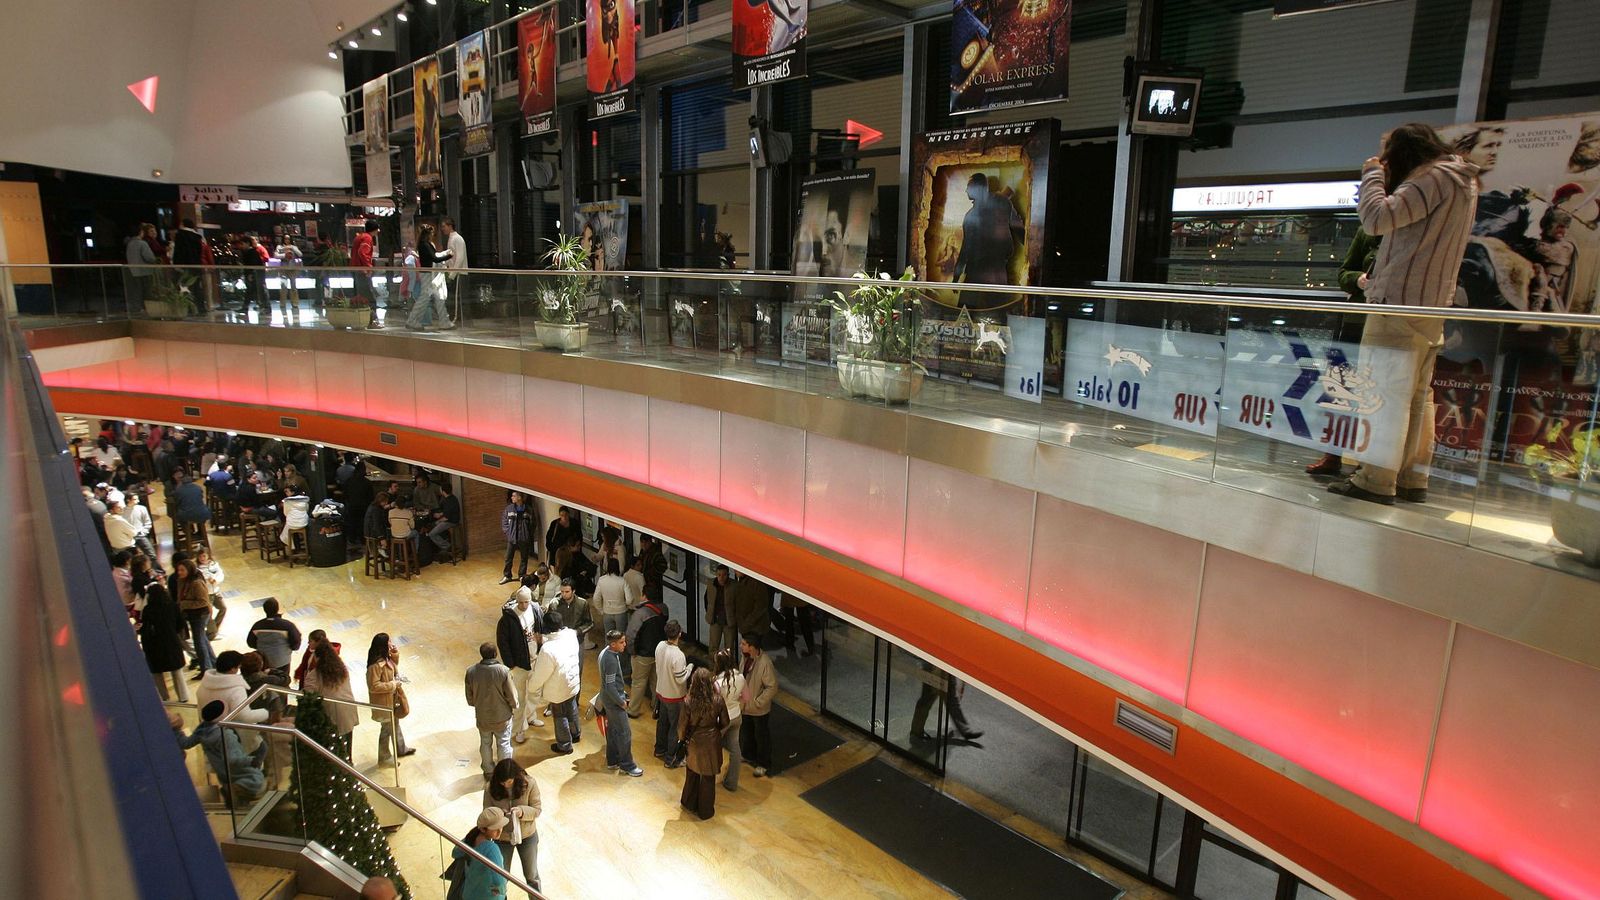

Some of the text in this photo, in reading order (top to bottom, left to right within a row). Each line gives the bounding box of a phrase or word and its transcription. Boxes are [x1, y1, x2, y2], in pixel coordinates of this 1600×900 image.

[747, 68, 757, 85] LOS
[1006, 62, 1056, 81] EXPRESS
[928, 126, 1032, 142] NICOLAS CAGE
[1528, 129, 1566, 137] FORTUNA
[1433, 379, 1472, 390] KILMER
[1506, 386, 1556, 399] DAWSON
